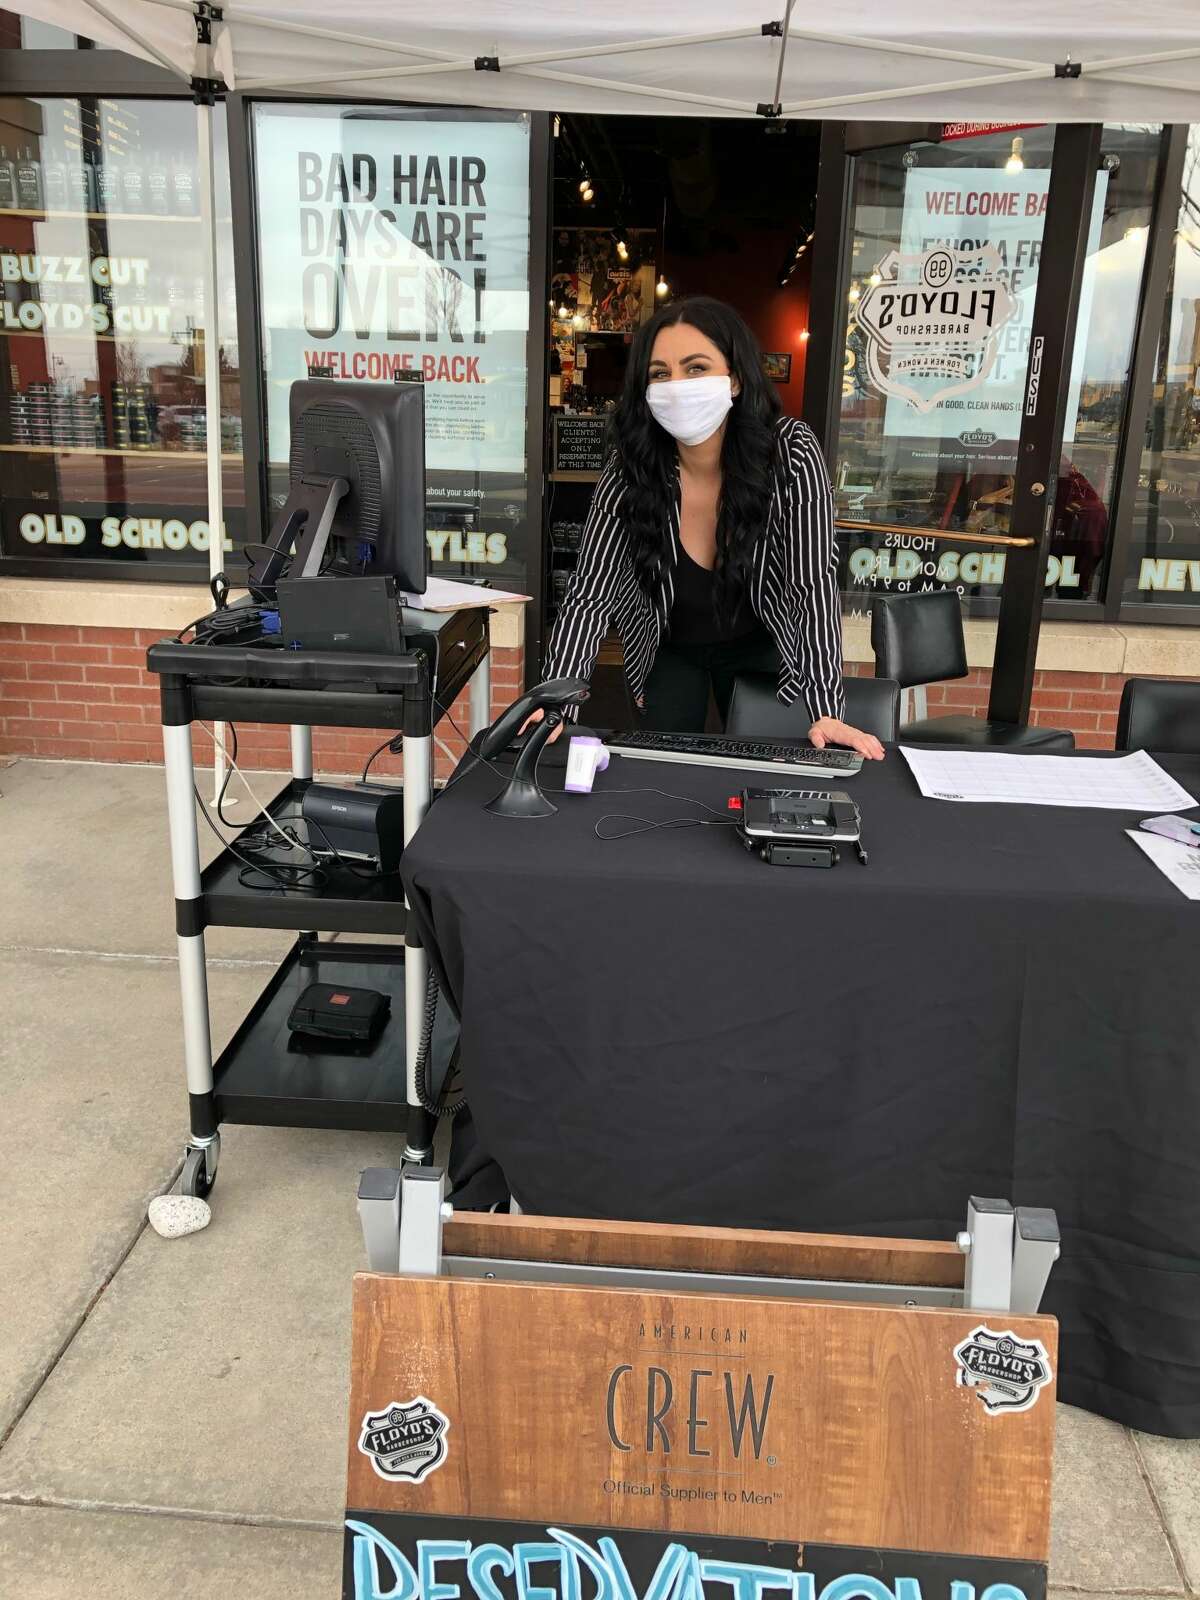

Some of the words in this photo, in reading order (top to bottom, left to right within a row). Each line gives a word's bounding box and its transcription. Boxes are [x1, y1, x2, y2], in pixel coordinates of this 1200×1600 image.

[298, 152, 377, 203] BAD
[393, 155, 486, 206] HAIR
[926, 192, 1019, 216] WELCOME
[300, 208, 397, 260] DAYS
[411, 211, 487, 262] ARE
[1, 254, 86, 283] BUZZ
[91, 256, 150, 287] CUT
[0, 299, 110, 332] LOYD'S
[114, 304, 171, 333] CUT
[303, 262, 487, 343] OVER!
[304, 351, 414, 380] WELCOME
[423, 354, 486, 384] BACK.
[1027, 338, 1043, 415] PUSH
[967, 401, 989, 410] CLEAN
[990, 402, 1014, 411] HANDS
[426, 487, 445, 496] about
[447, 489, 461, 498] your
[19, 513, 87, 545] OLD
[849, 547, 921, 580] OLD
[937, 552, 1080, 587] SCHL
[639, 1322, 747, 1344] AMERICAN
[968, 1347, 1035, 1381] FLOYD'S
[371, 1419, 434, 1451] FLOYD'S
[603, 1480, 655, 1497] Official
[660, 1483, 719, 1502] Supplier
[724, 1491, 737, 1503] to
